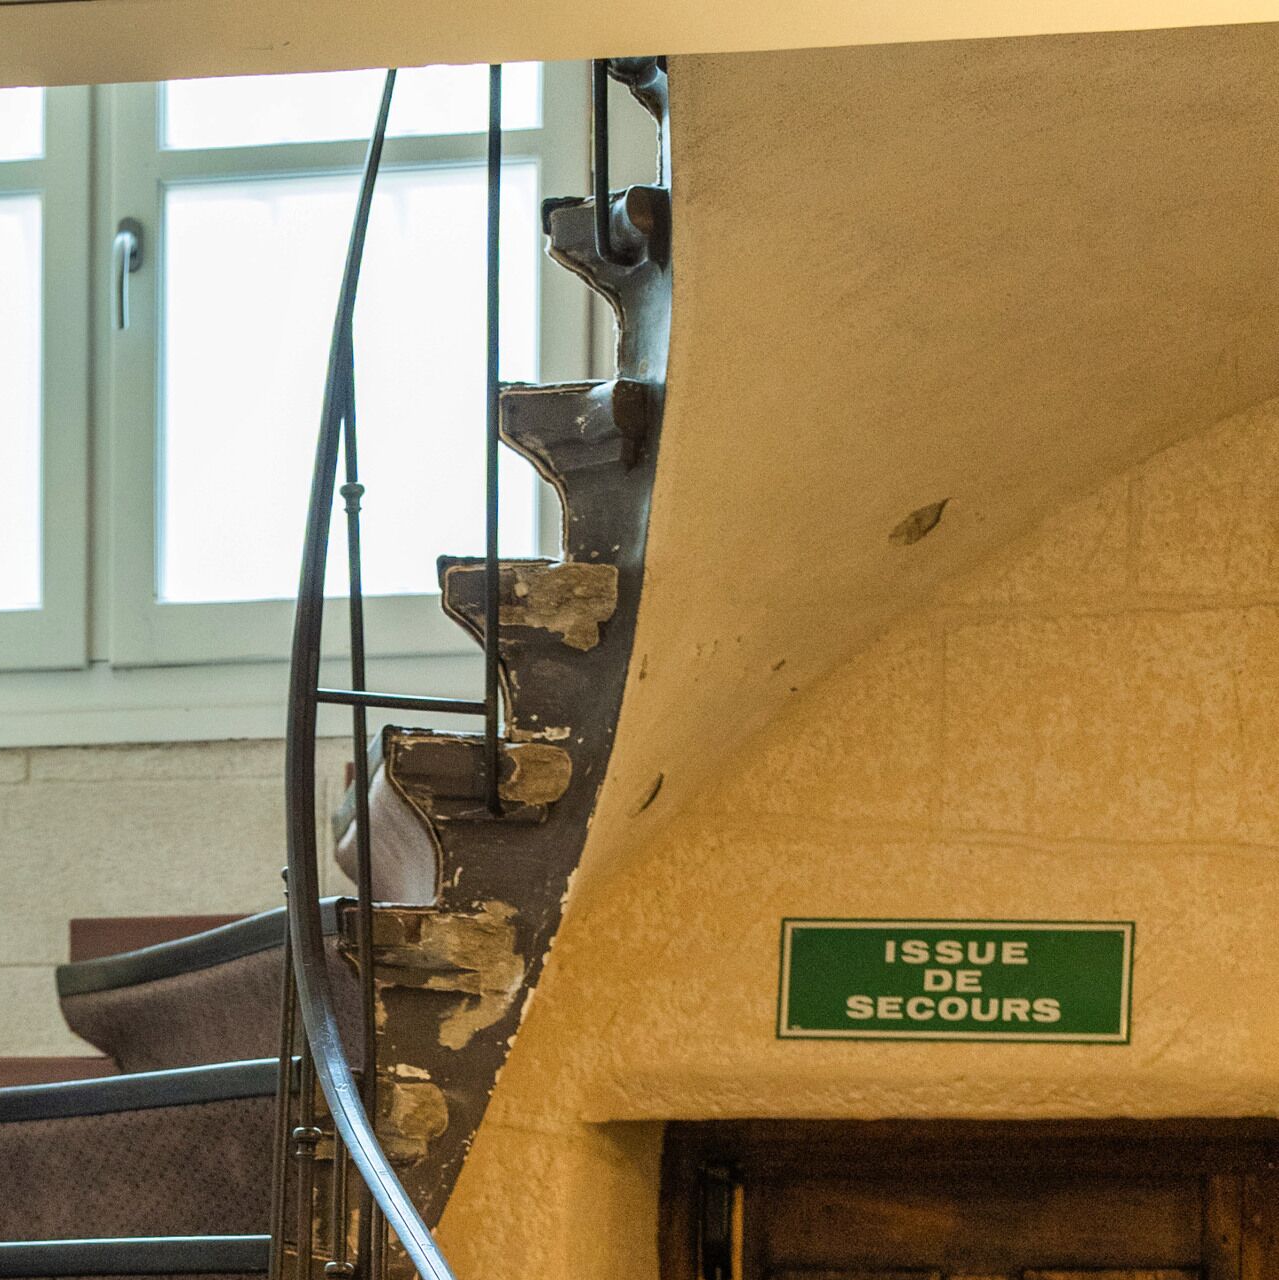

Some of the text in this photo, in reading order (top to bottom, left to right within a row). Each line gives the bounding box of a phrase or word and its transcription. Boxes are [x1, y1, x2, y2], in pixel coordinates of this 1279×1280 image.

[884, 940, 1029, 965] ISSUE
[923, 969, 983, 993] DE
[845, 995, 1062, 1023] SECOURS
